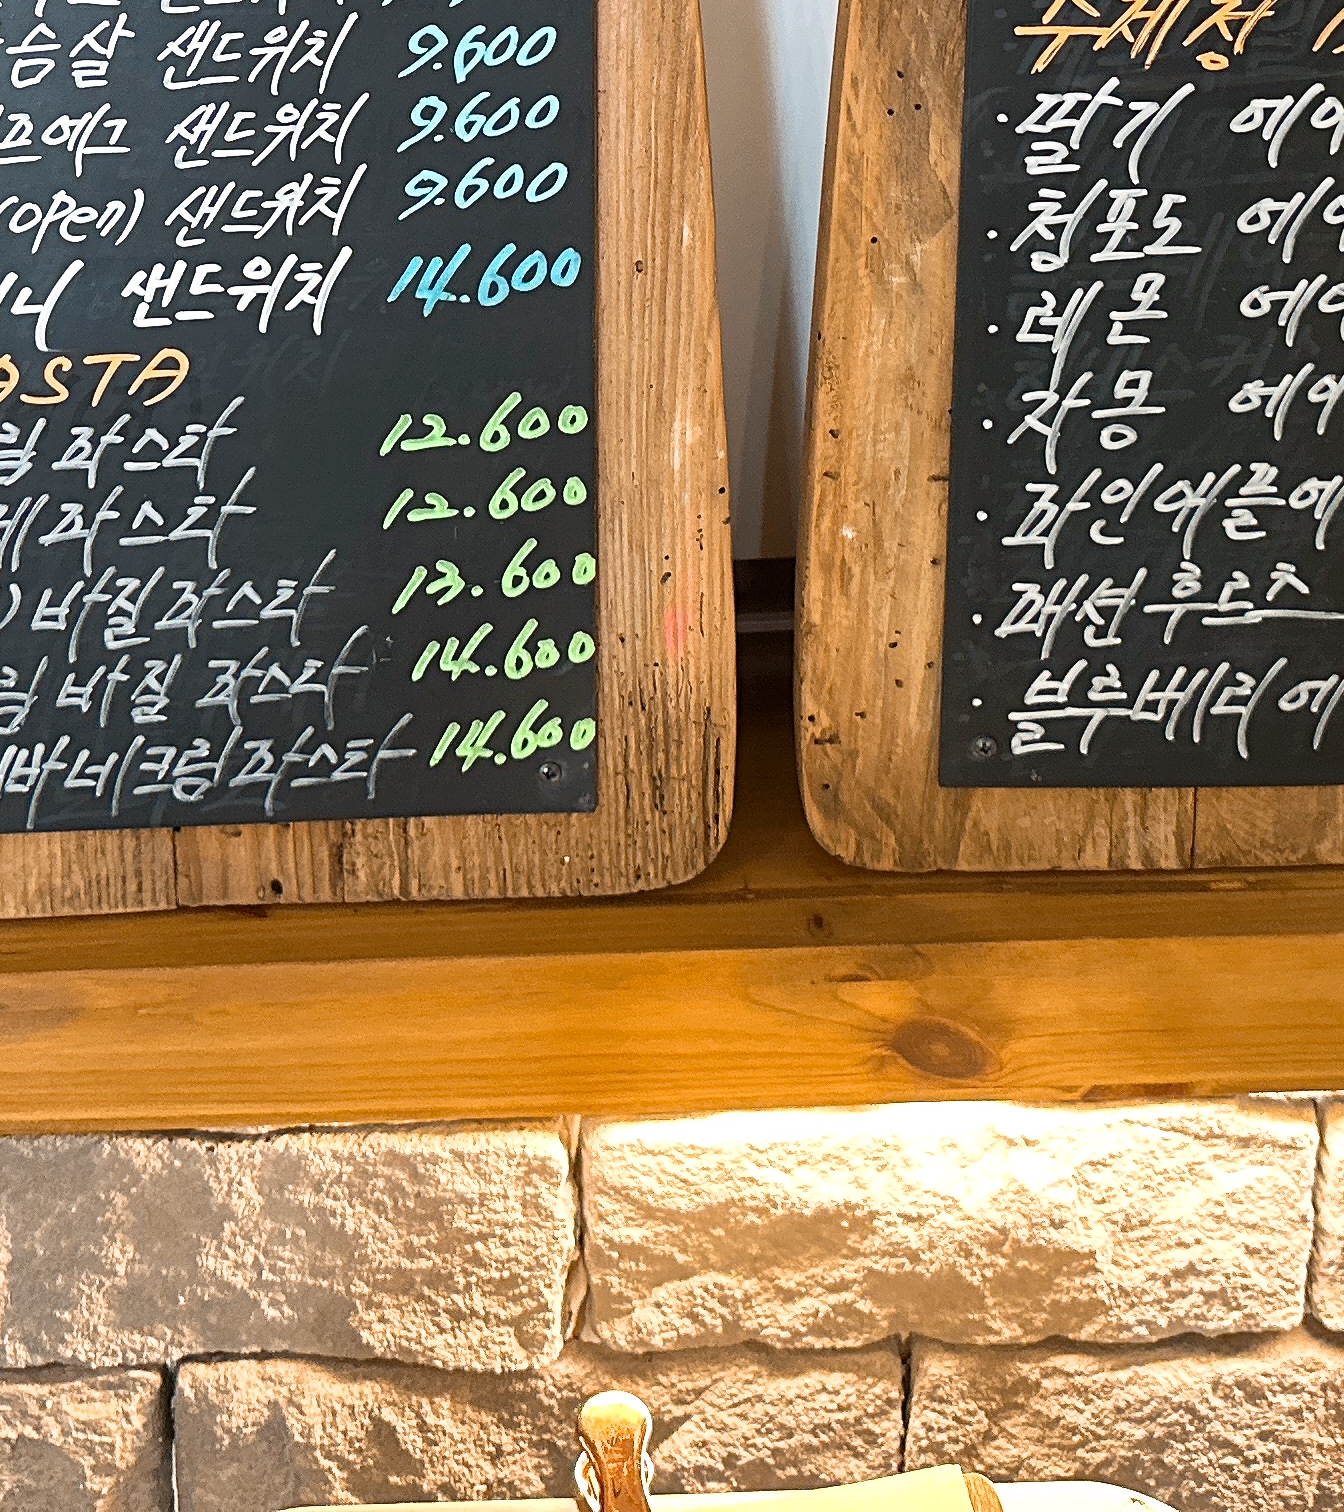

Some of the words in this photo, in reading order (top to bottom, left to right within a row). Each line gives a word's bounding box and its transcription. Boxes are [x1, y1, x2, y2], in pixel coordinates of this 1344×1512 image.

[157, 12, 358, 95] 샌드위치
[398, 25, 556, 84] 9.600
[165, 93, 369, 169] 샌드위치
[397, 92, 559, 153] 9.600
[1015, 77, 1195, 185] 딸기
[165, 163, 367, 247] 샌드위치
[398, 157, 567, 220] 9.600
[1010, 179, 1202, 272] 청포도
[121, 246, 352, 335] 샌드위치
[387, 243, 580, 317] 14.600
[1016, 273, 1168, 392] 레몬
[380, 392, 587, 456] 12.600
[1007, 370, 1165, 474] 자몽
[383, 467, 588, 529] 12.600
[392, 538, 597, 614] 13.600
[412, 619, 595, 681] 14.600
[430, 699, 595, 772] 14.600
